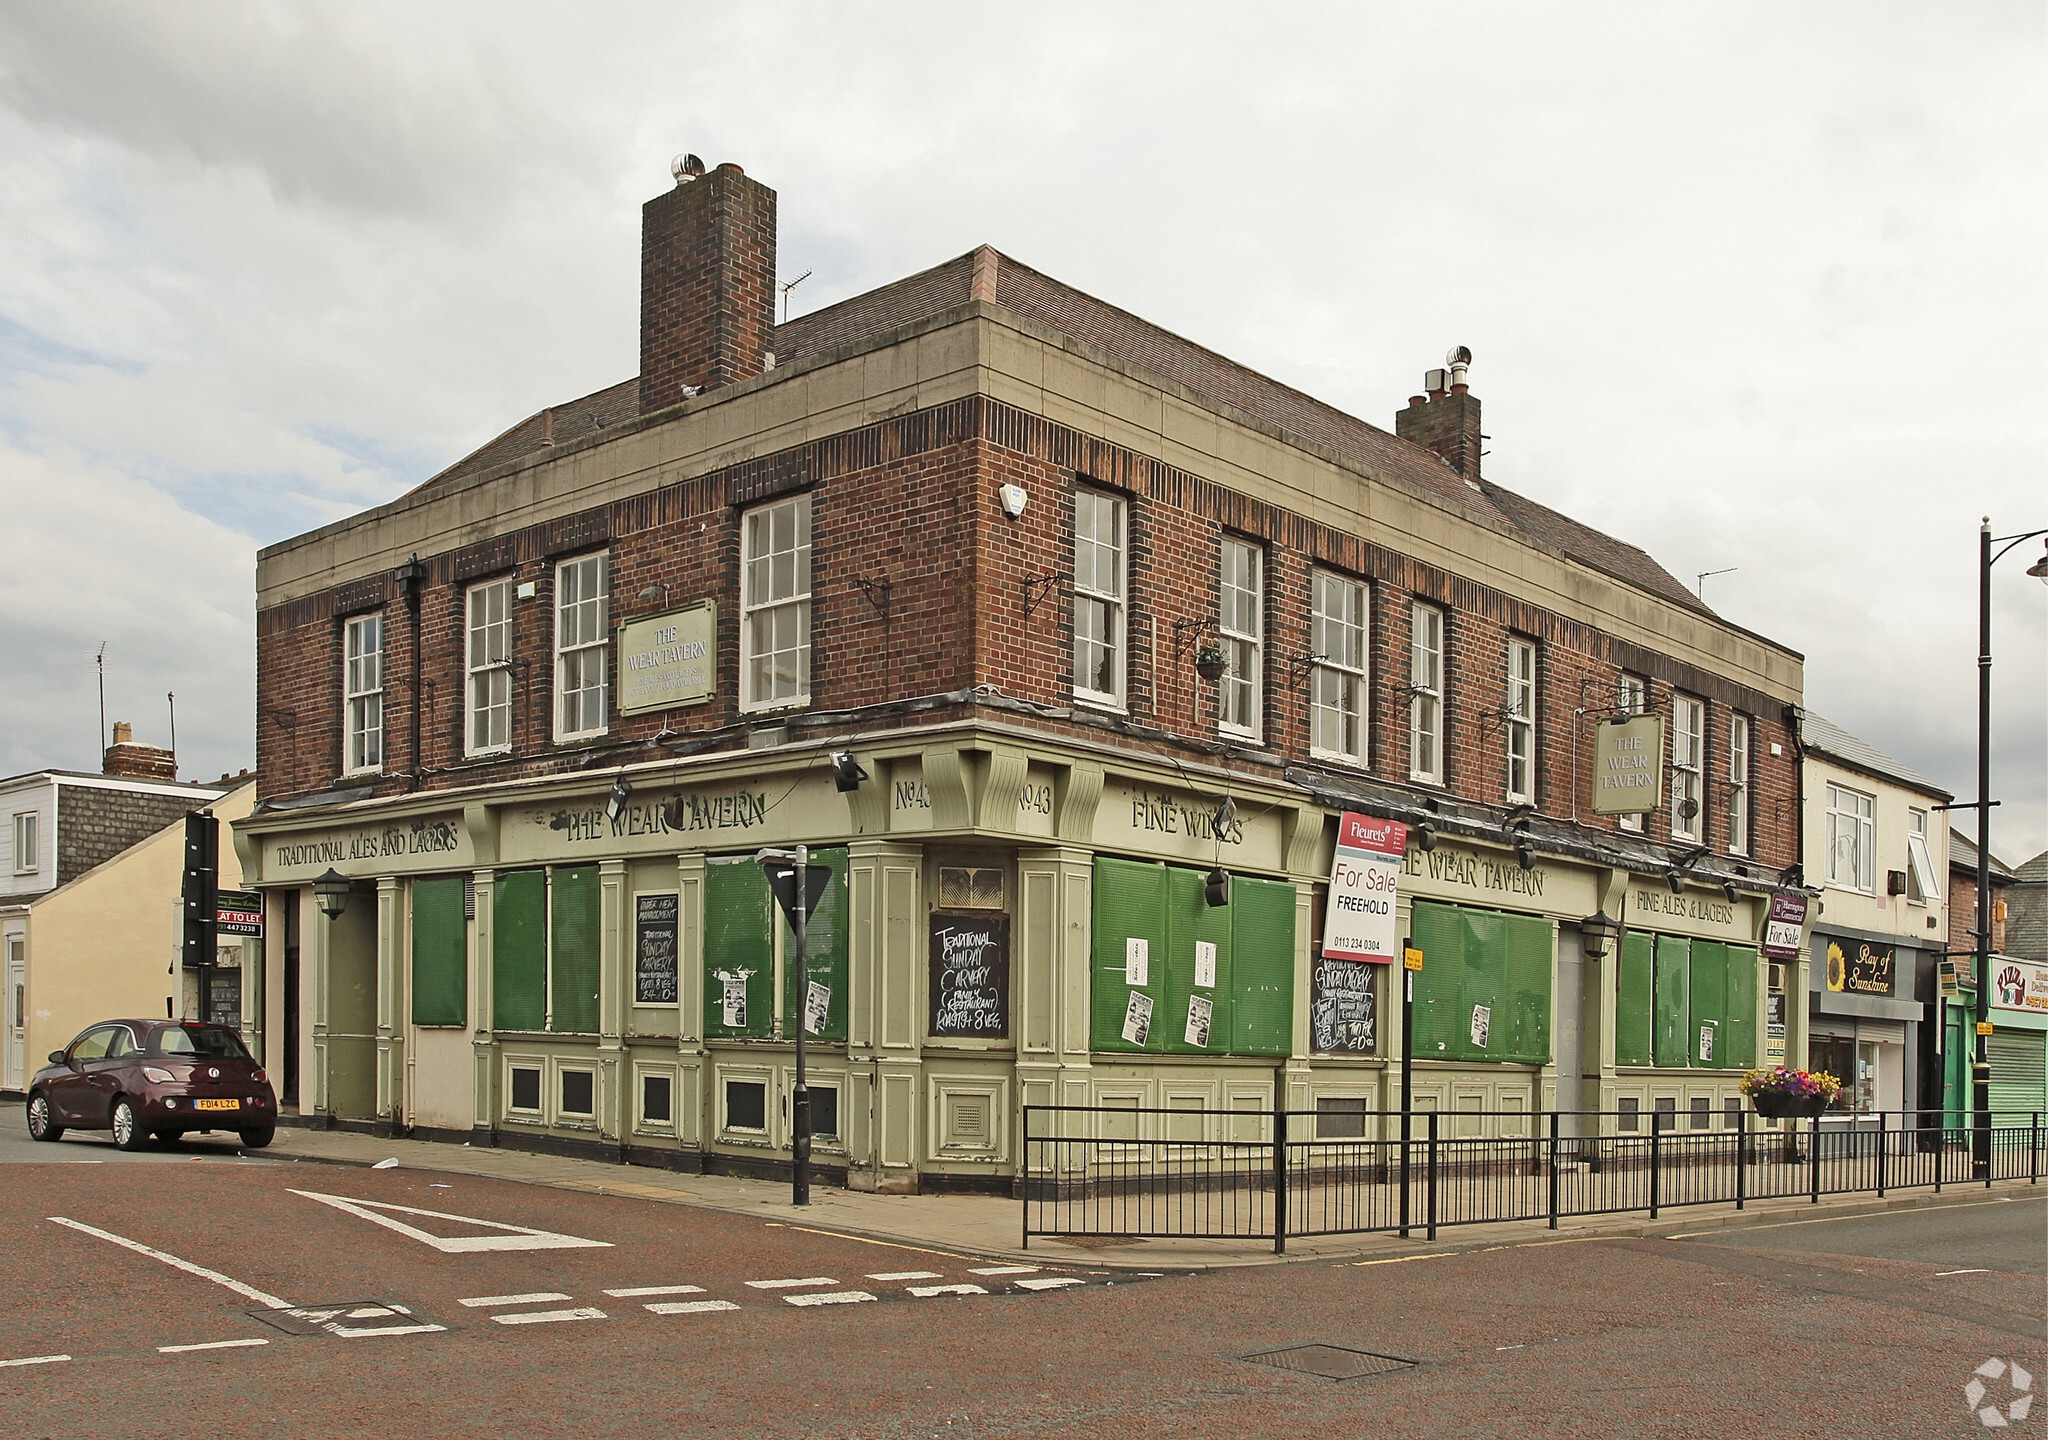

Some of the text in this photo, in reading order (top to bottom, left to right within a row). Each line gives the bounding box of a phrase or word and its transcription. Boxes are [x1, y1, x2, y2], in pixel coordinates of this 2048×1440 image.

[654, 626, 677, 646] THE
[628, 641, 706, 671] WEAR TAVERN
[1615, 737, 1642, 751] THE
[1608, 755, 1648, 770] WEAR
[1601, 774, 1654, 789] TAVERN
[567, 808, 602, 841] THE
[1132, 800, 1178, 834] FINE
[1351, 822, 1386, 842] Fleurets
[277, 840, 345, 866] TRADITIONAL
[349, 835, 378, 860] ALES
[380, 830, 406, 856] AND
[1334, 863, 1396, 893] For Sale
[1399, 847, 1546, 897] HE WEAR TAVERN
[1337, 895, 1389, 915] FREEHOLD
[1637, 890, 1733, 924] FINE ALES & LAGERS
[246, 914, 260, 922] LET
[934, 927, 997, 949] TRADITIONAL
[1334, 936, 1380, 950] 0113 234 0304
[1769, 925, 1798, 945] For Sale
[641, 939, 673, 958] SUNDAY
[942, 945, 984, 969] SUNDAY
[1856, 944, 1893, 974] Ray of
[641, 955, 675, 971] CARVERY
[940, 966, 991, 992] CARVERY
[1849, 967, 1889, 992] Sunshine
[974, 1009, 984, 1030] 8
[201, 1100, 236, 1108] FD14 LZC
